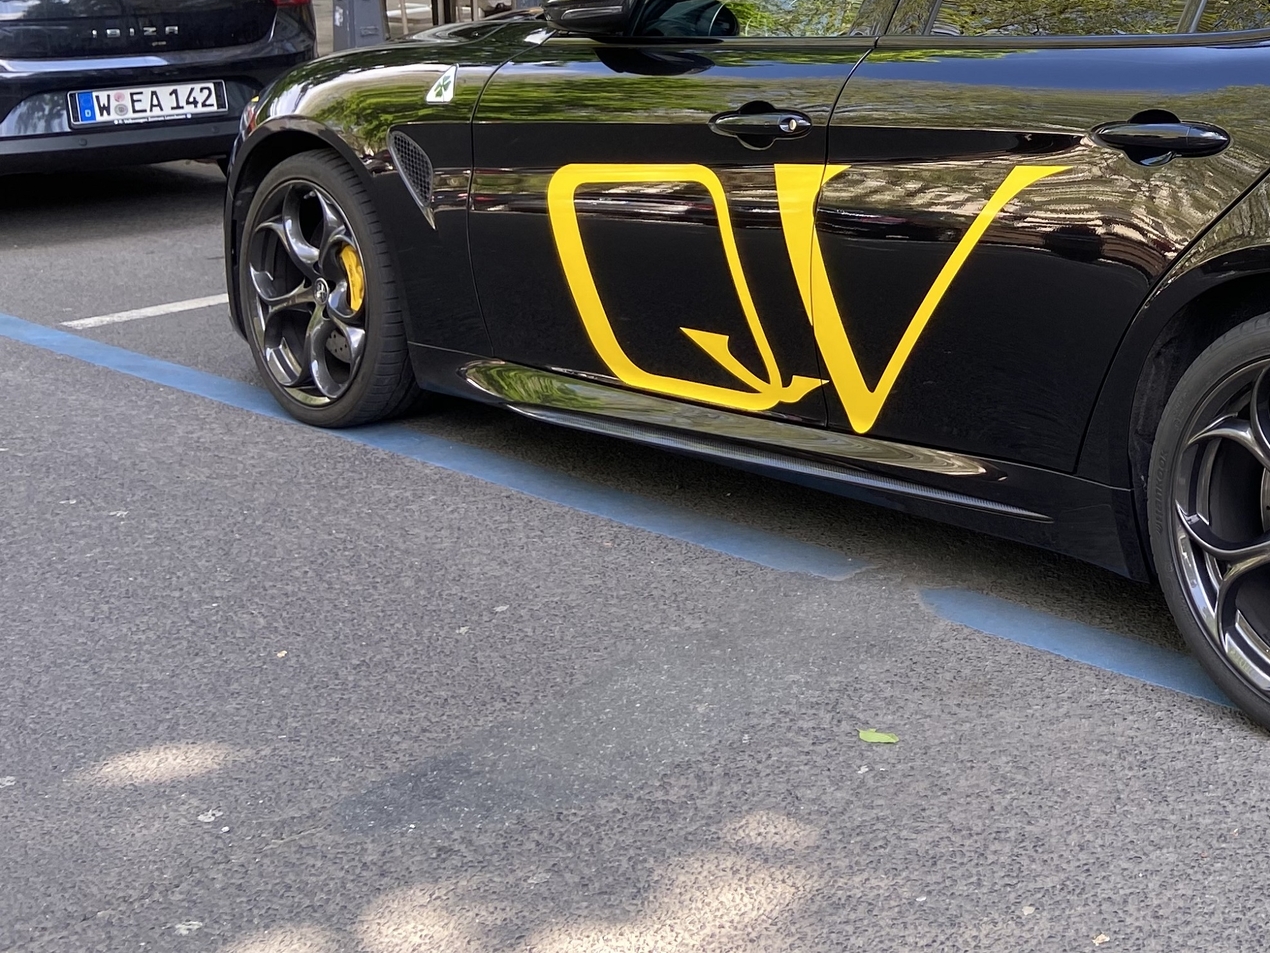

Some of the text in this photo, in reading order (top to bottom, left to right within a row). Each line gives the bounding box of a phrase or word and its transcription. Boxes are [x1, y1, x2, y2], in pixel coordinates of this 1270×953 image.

[95, 94, 111, 118] W
[130, 90, 164, 114] EA
[169, 86, 215, 111] 142
[547, 163, 1073, 434] QV
